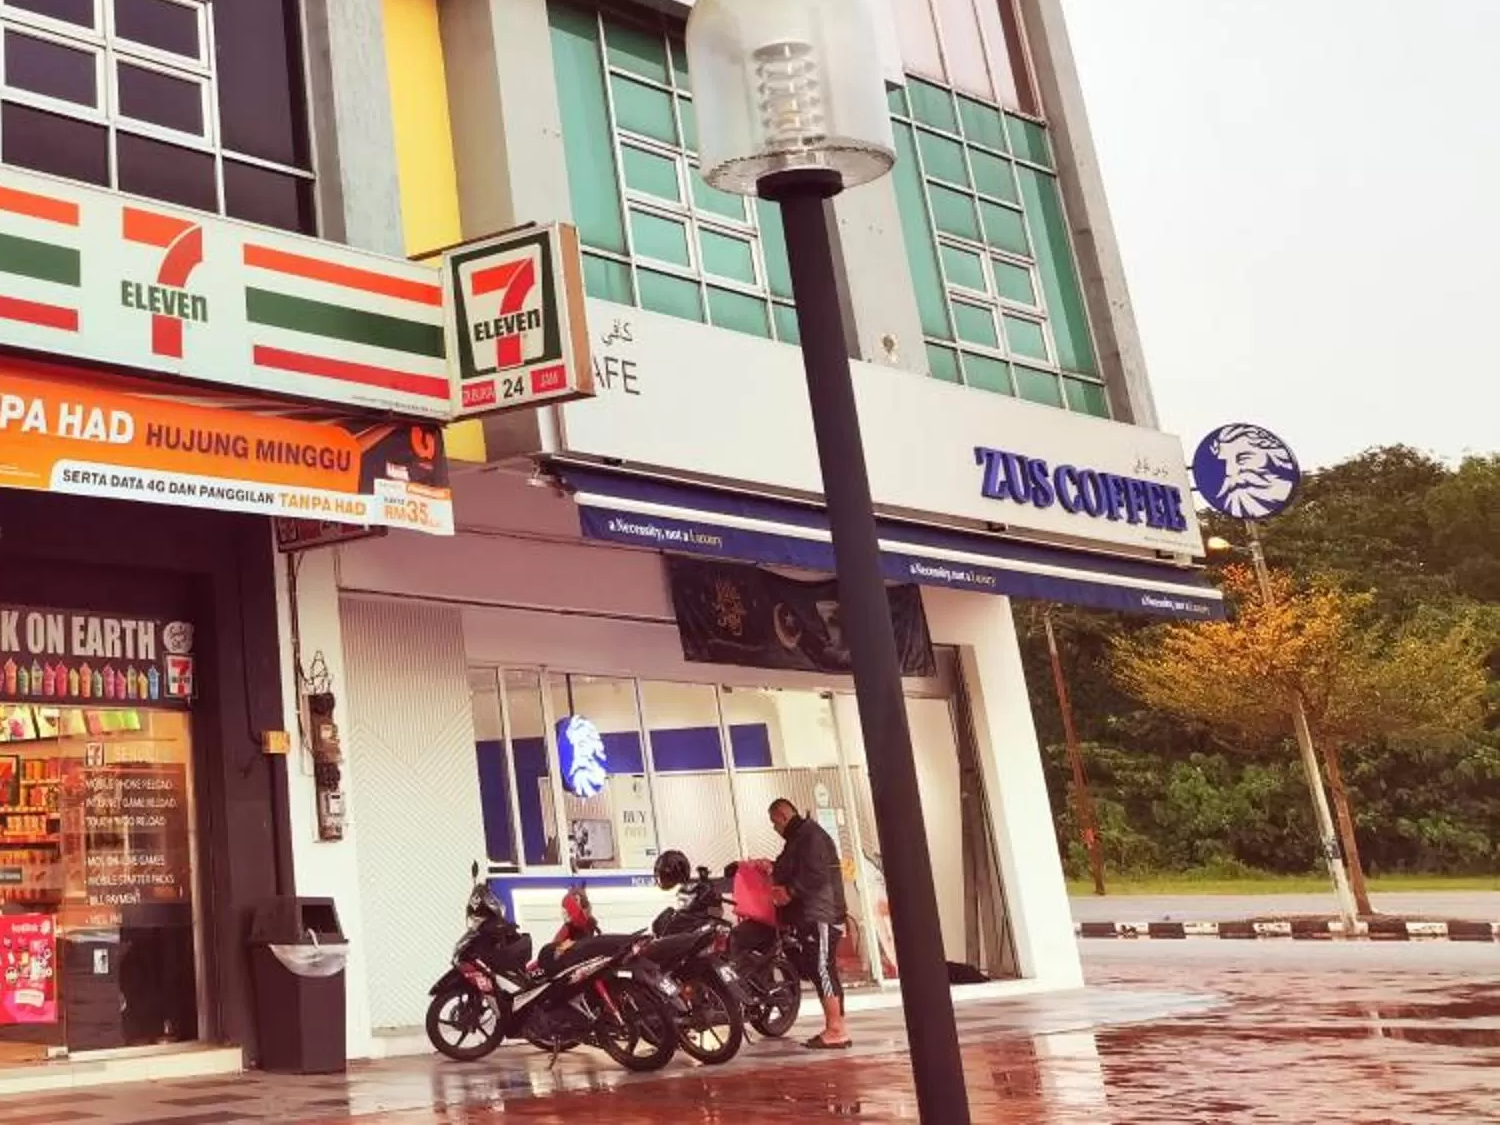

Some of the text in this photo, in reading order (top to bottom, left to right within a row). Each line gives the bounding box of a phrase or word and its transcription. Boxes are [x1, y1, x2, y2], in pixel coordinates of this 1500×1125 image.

[122, 205, 204, 360] 7
[471, 255, 536, 369] 7
[502, 375, 525, 399] 24
[57, 401, 135, 445] HAD
[145, 422, 250, 460] HUJUNG
[255, 438, 351, 472] MINGGU
[62, 469, 107, 487] SERTA
[110, 473, 144, 491] DATA
[147, 478, 166, 493] 4G
[169, 481, 196, 497] DAN
[199, 484, 275, 505] PANGGILAN
[279, 492, 332, 512] TANPA
[335, 497, 367, 517] HAD
[973, 446, 1188, 533] ZUS COFFEE
[27, 610, 67, 656] ON
[71, 615, 158, 661] EARTH
